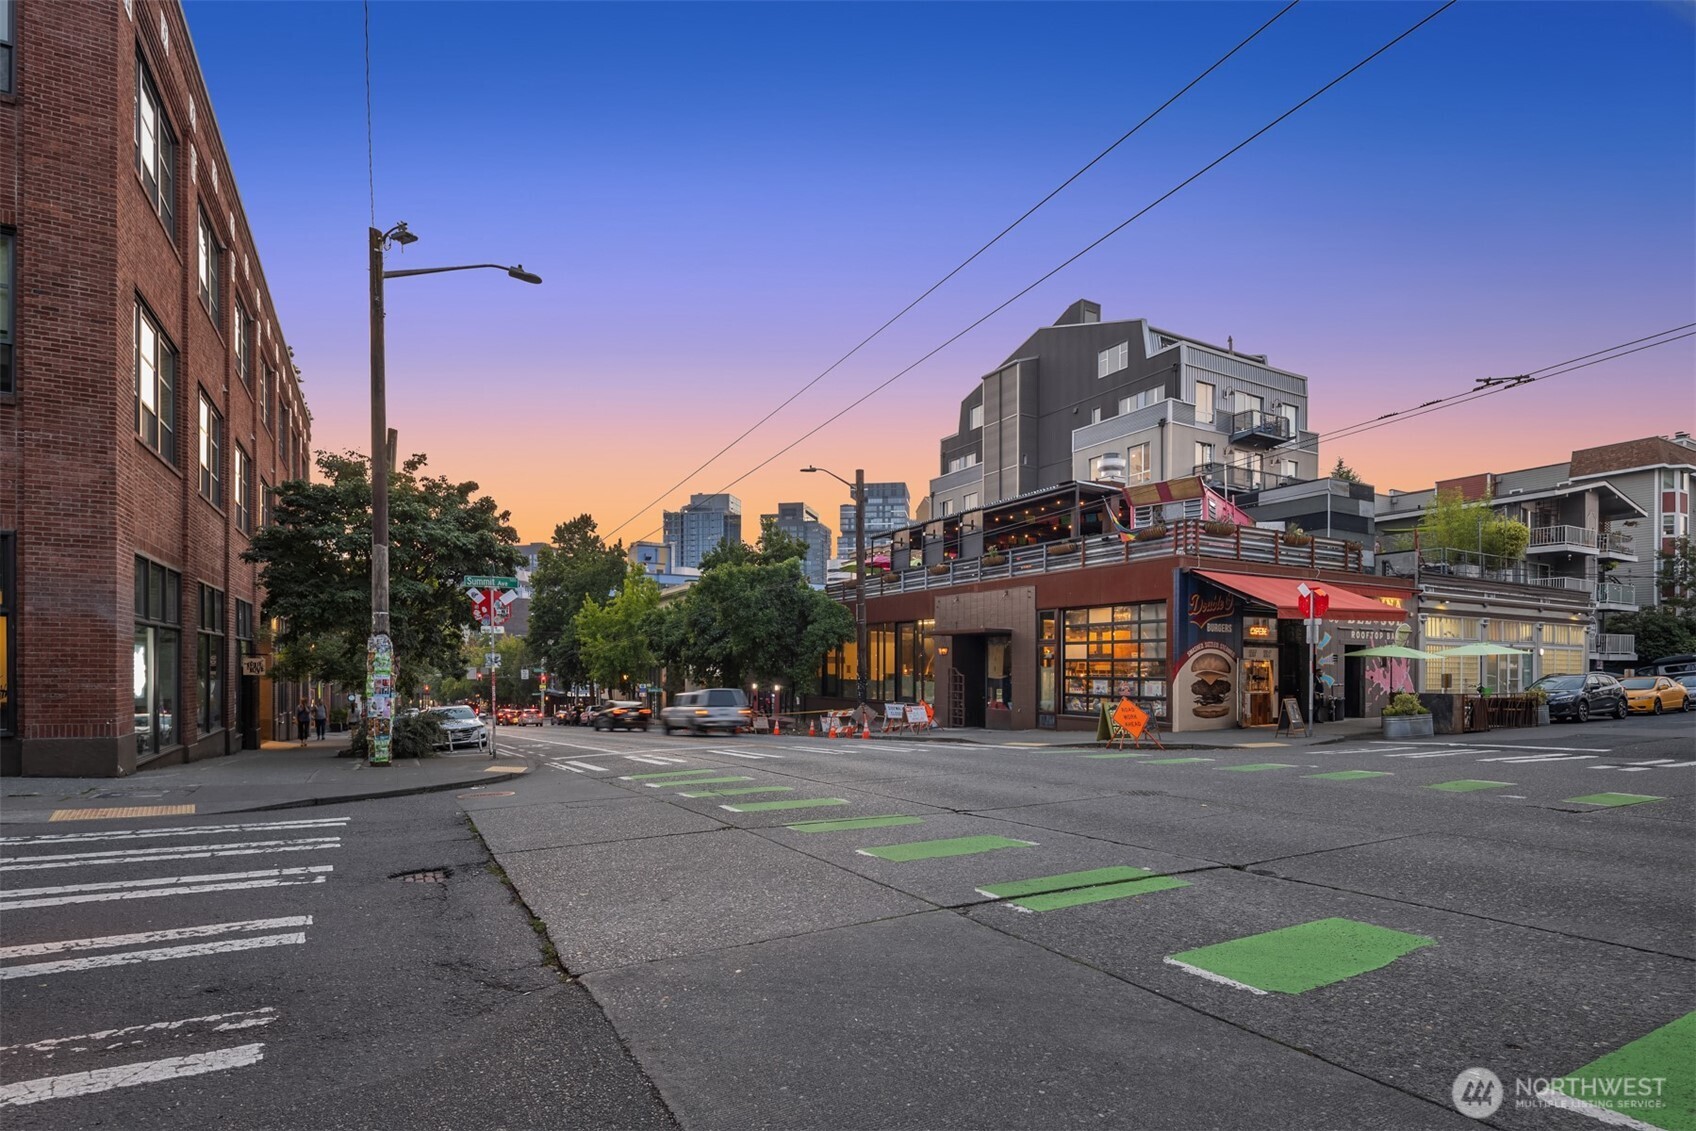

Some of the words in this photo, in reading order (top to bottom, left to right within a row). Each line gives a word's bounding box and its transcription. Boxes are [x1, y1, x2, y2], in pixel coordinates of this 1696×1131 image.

[467, 577, 495, 586] Summit
[1207, 623, 1233, 633] BURGERS
[1250, 626, 1267, 636] OPEN
[1351, 631, 1384, 640] ROOFTOP
[1386, 632, 1396, 640] BA
